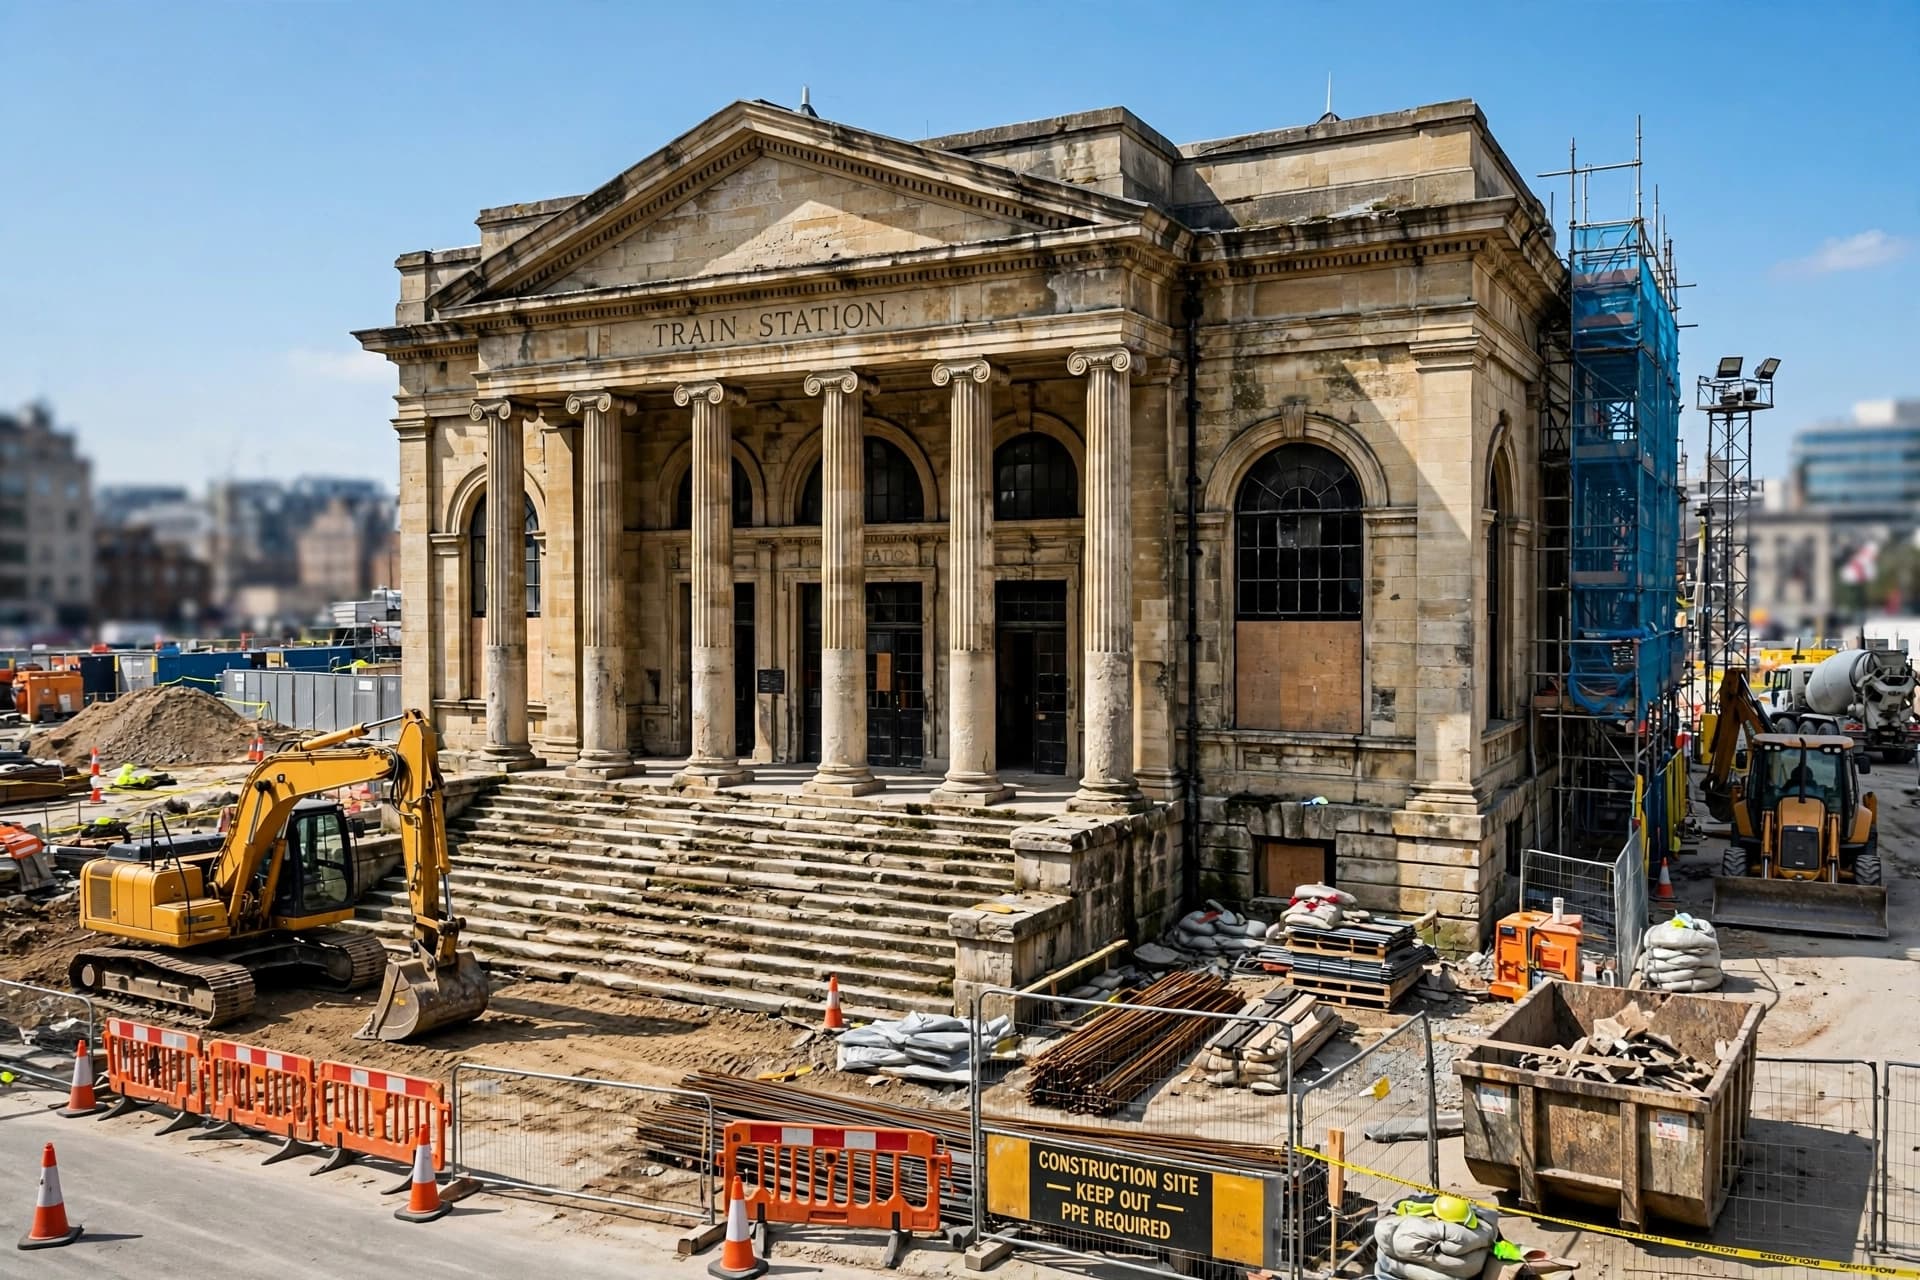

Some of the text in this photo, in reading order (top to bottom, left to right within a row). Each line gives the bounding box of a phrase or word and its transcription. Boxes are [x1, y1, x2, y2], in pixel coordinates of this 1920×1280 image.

[653, 300, 885, 347] TRAIN STATION
[1039, 1150, 1199, 1196] CONSTRUCTION SITE
[1076, 1181, 1151, 1213] KEEP OUT
[1061, 1202, 1171, 1240] PPE REQUIRED
